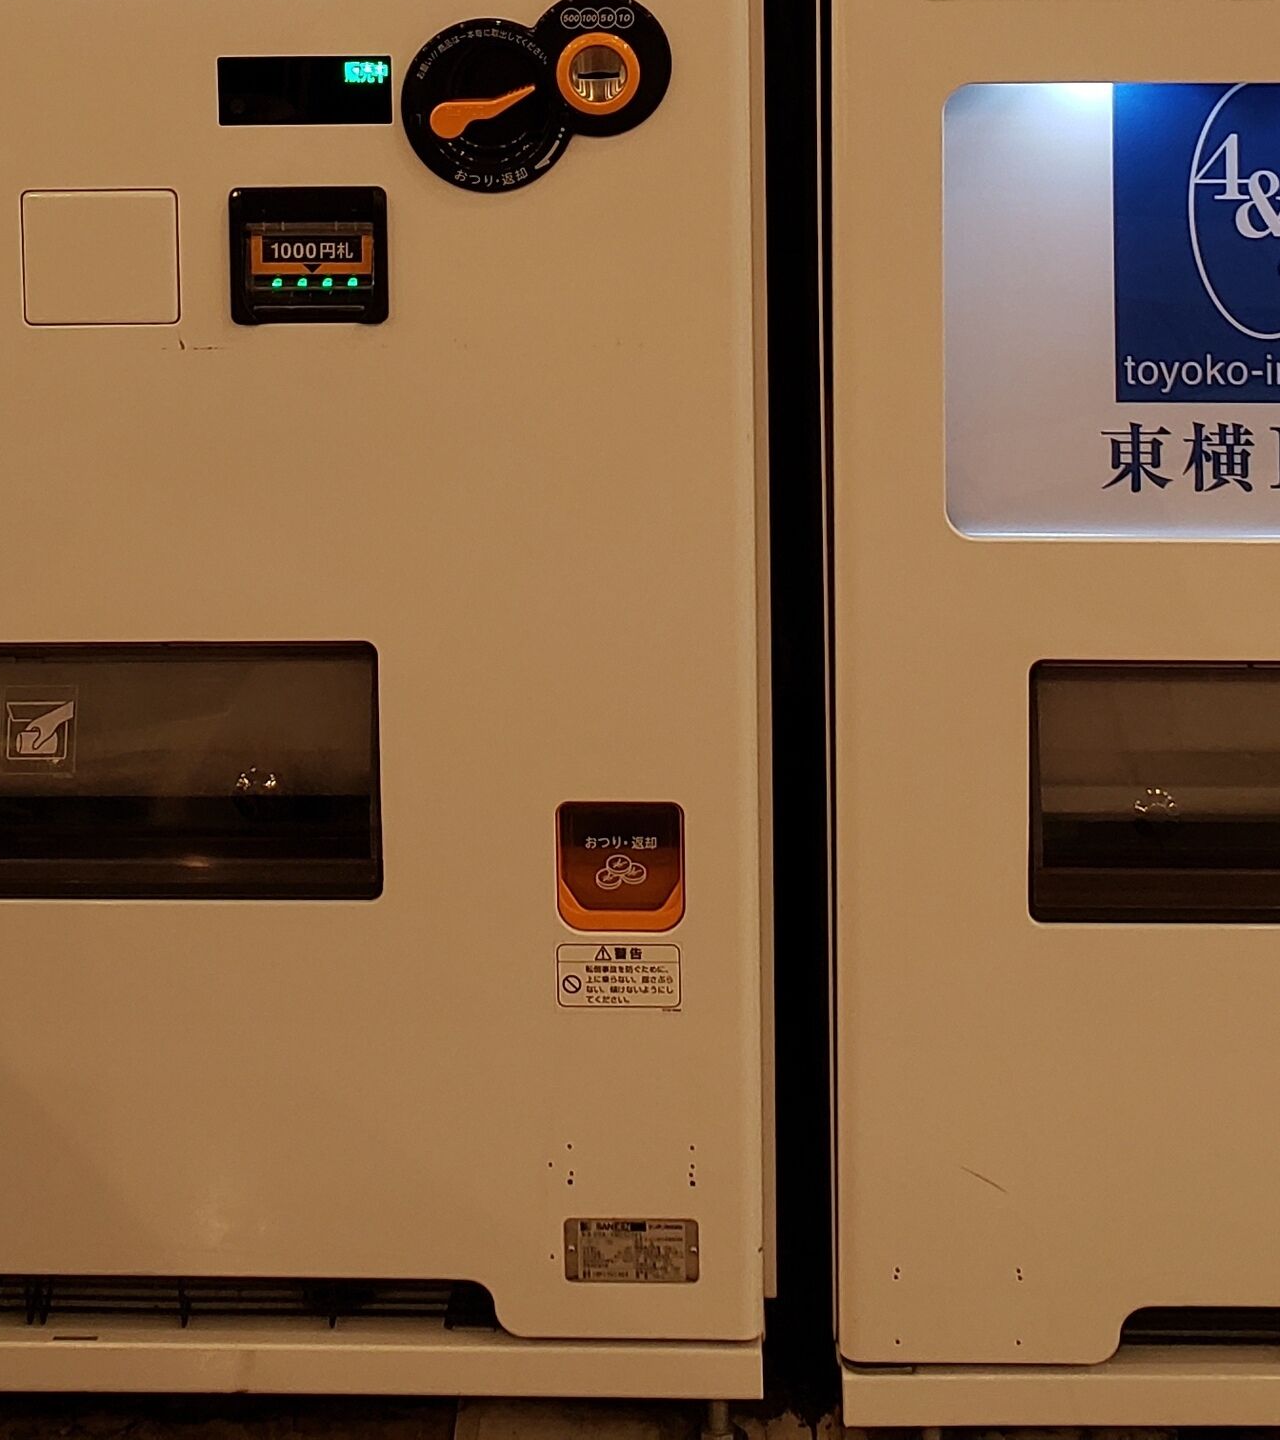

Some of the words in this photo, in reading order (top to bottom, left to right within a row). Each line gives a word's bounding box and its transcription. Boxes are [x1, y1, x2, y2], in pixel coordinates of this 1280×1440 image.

[563, 14, 579, 22] 500
[582, 14, 597, 22] 100
[600, 14, 613, 22] 50
[271, 242, 353, 259] 1000円札
